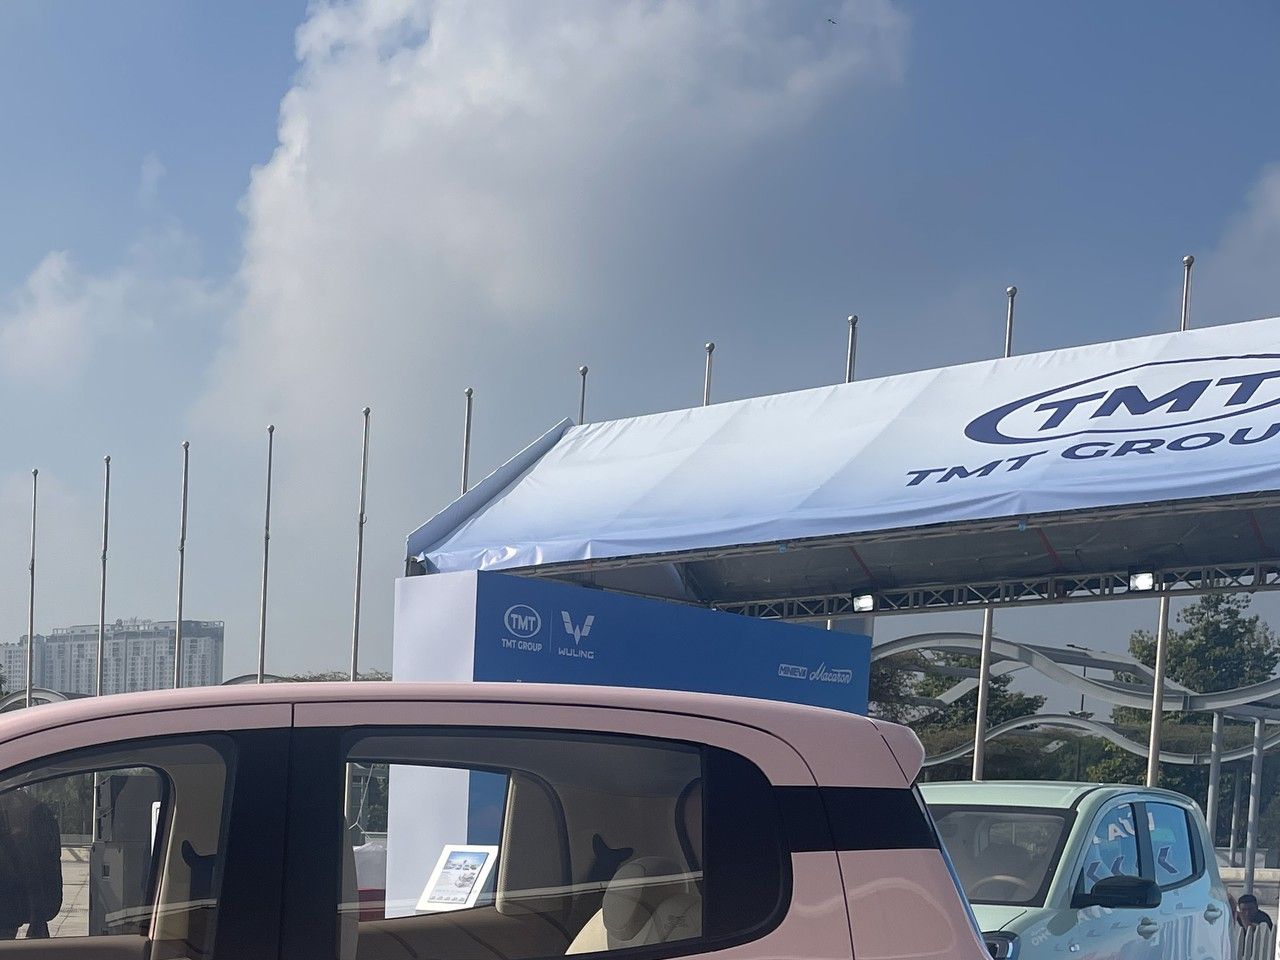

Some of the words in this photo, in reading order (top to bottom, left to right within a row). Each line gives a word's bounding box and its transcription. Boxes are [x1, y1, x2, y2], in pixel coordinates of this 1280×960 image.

[1034, 370, 1280, 432] TMT
[905, 450, 1049, 487] TMT
[1061, 422, 1280, 460] GROU
[510, 613, 536, 632] TMT
[502, 638, 517, 649] TMT
[517, 640, 543, 652] GROUP
[559, 647, 594, 659] WULING
